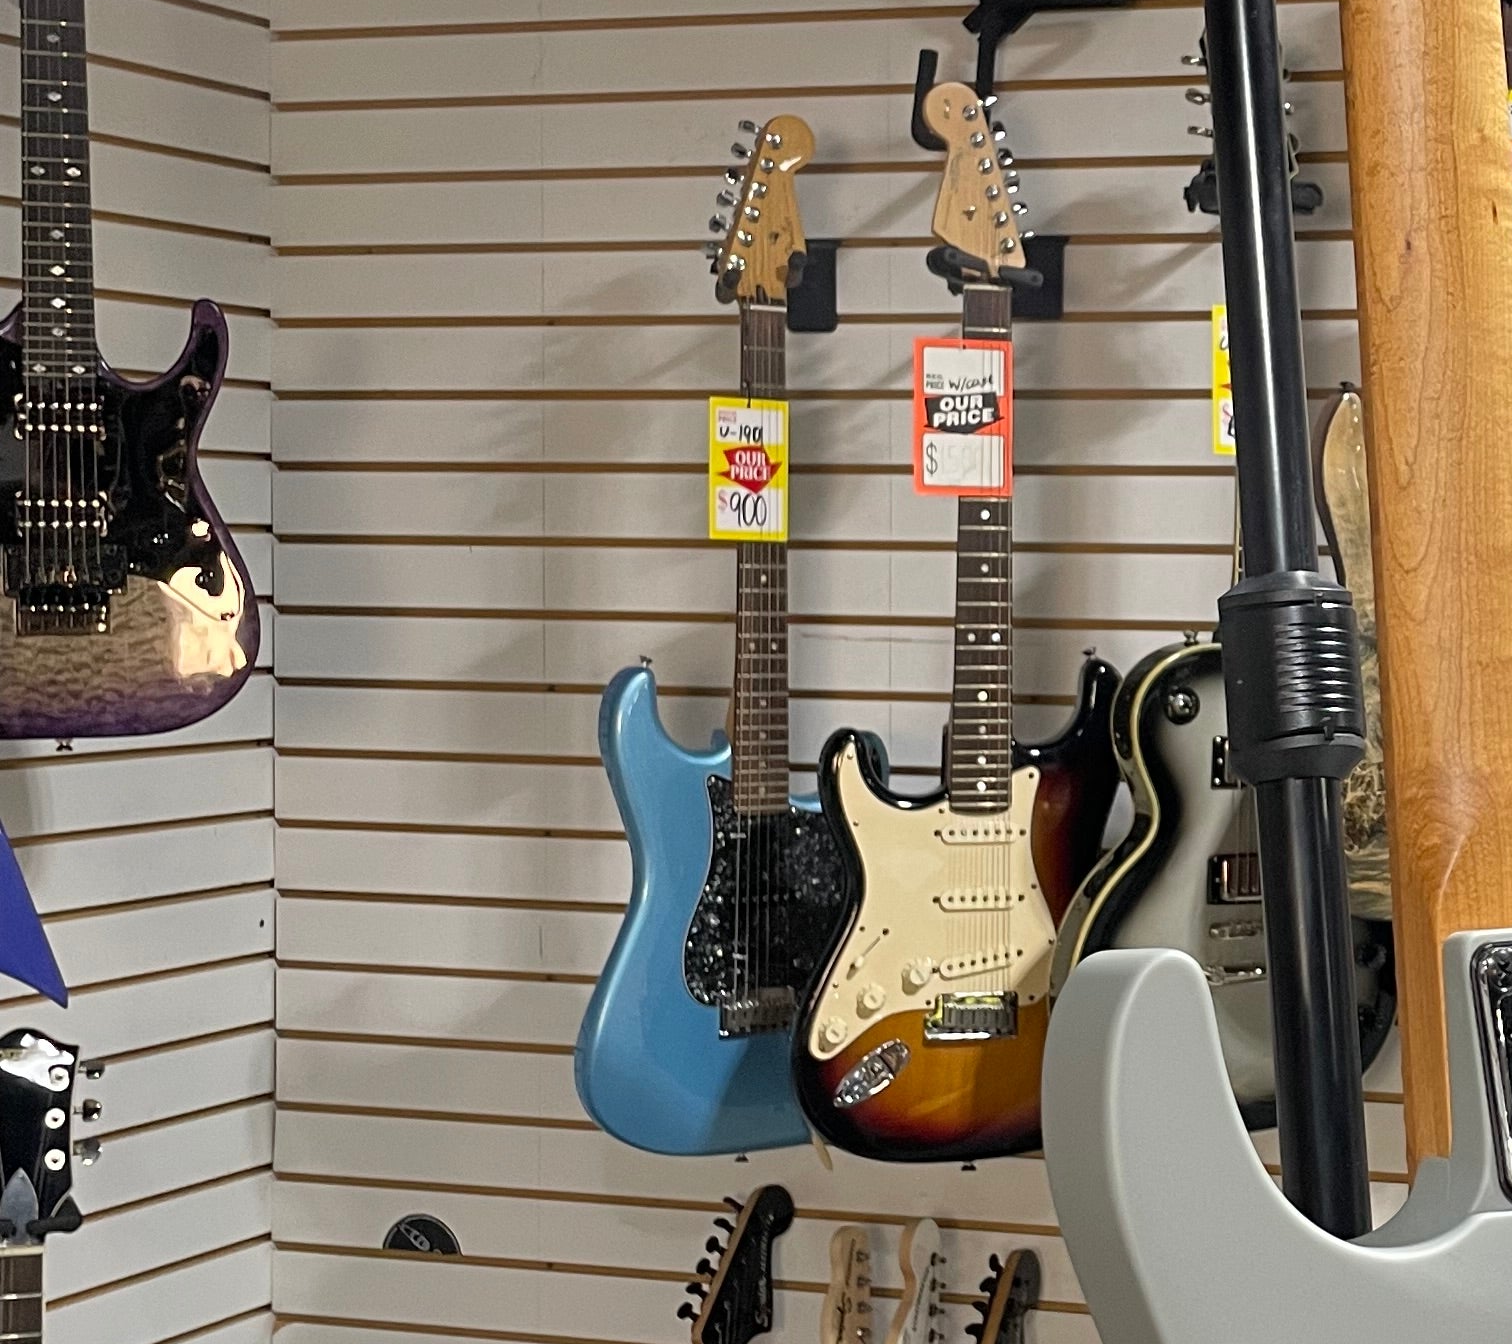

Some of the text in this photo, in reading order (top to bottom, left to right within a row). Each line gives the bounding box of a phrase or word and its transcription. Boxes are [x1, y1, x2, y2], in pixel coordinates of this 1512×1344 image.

[939, 394, 984, 412] OUR
[932, 407, 995, 428] PRICE
[734, 450, 767, 467] OUR
[730, 463, 772, 482] PRICE
